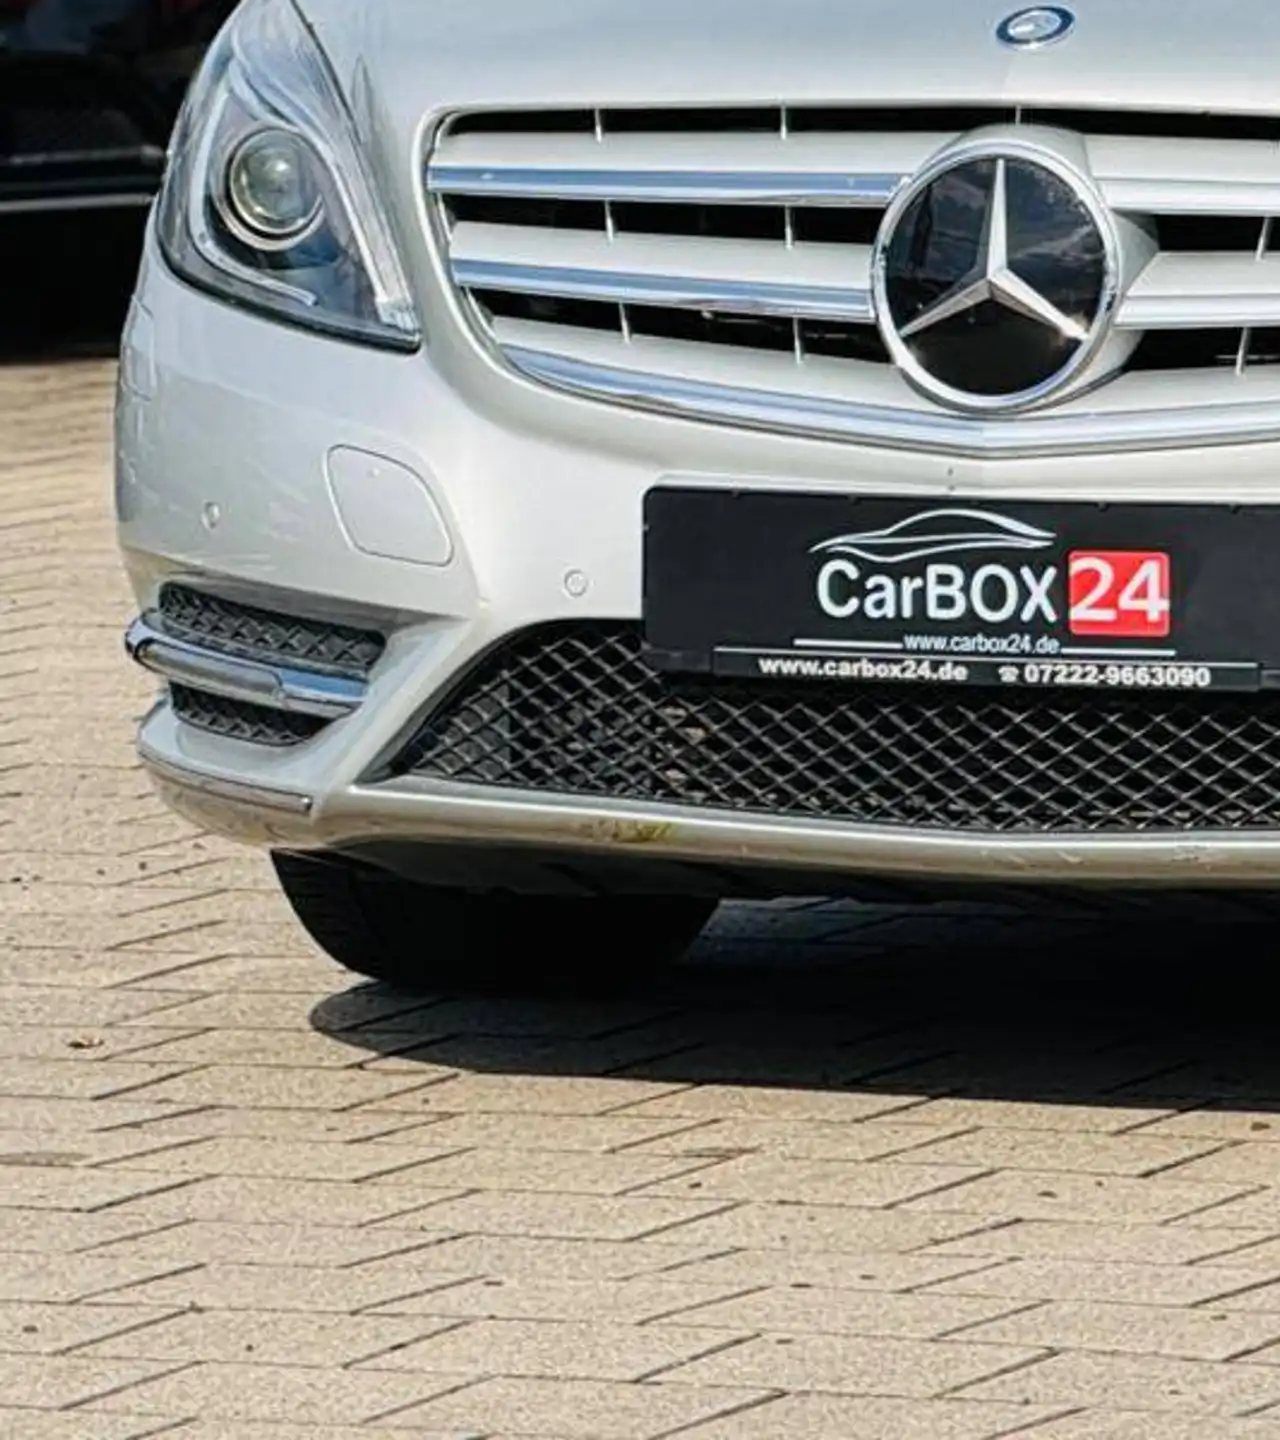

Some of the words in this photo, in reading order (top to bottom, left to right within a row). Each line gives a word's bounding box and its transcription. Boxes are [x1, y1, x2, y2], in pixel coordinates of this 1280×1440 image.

[1069, 557, 1171, 623] 24
[903, 632, 1061, 655] www.carbox24.de
[758, 657, 969, 682] www.carbox24.de
[1023, 663, 1212, 688] 07222-9663090
